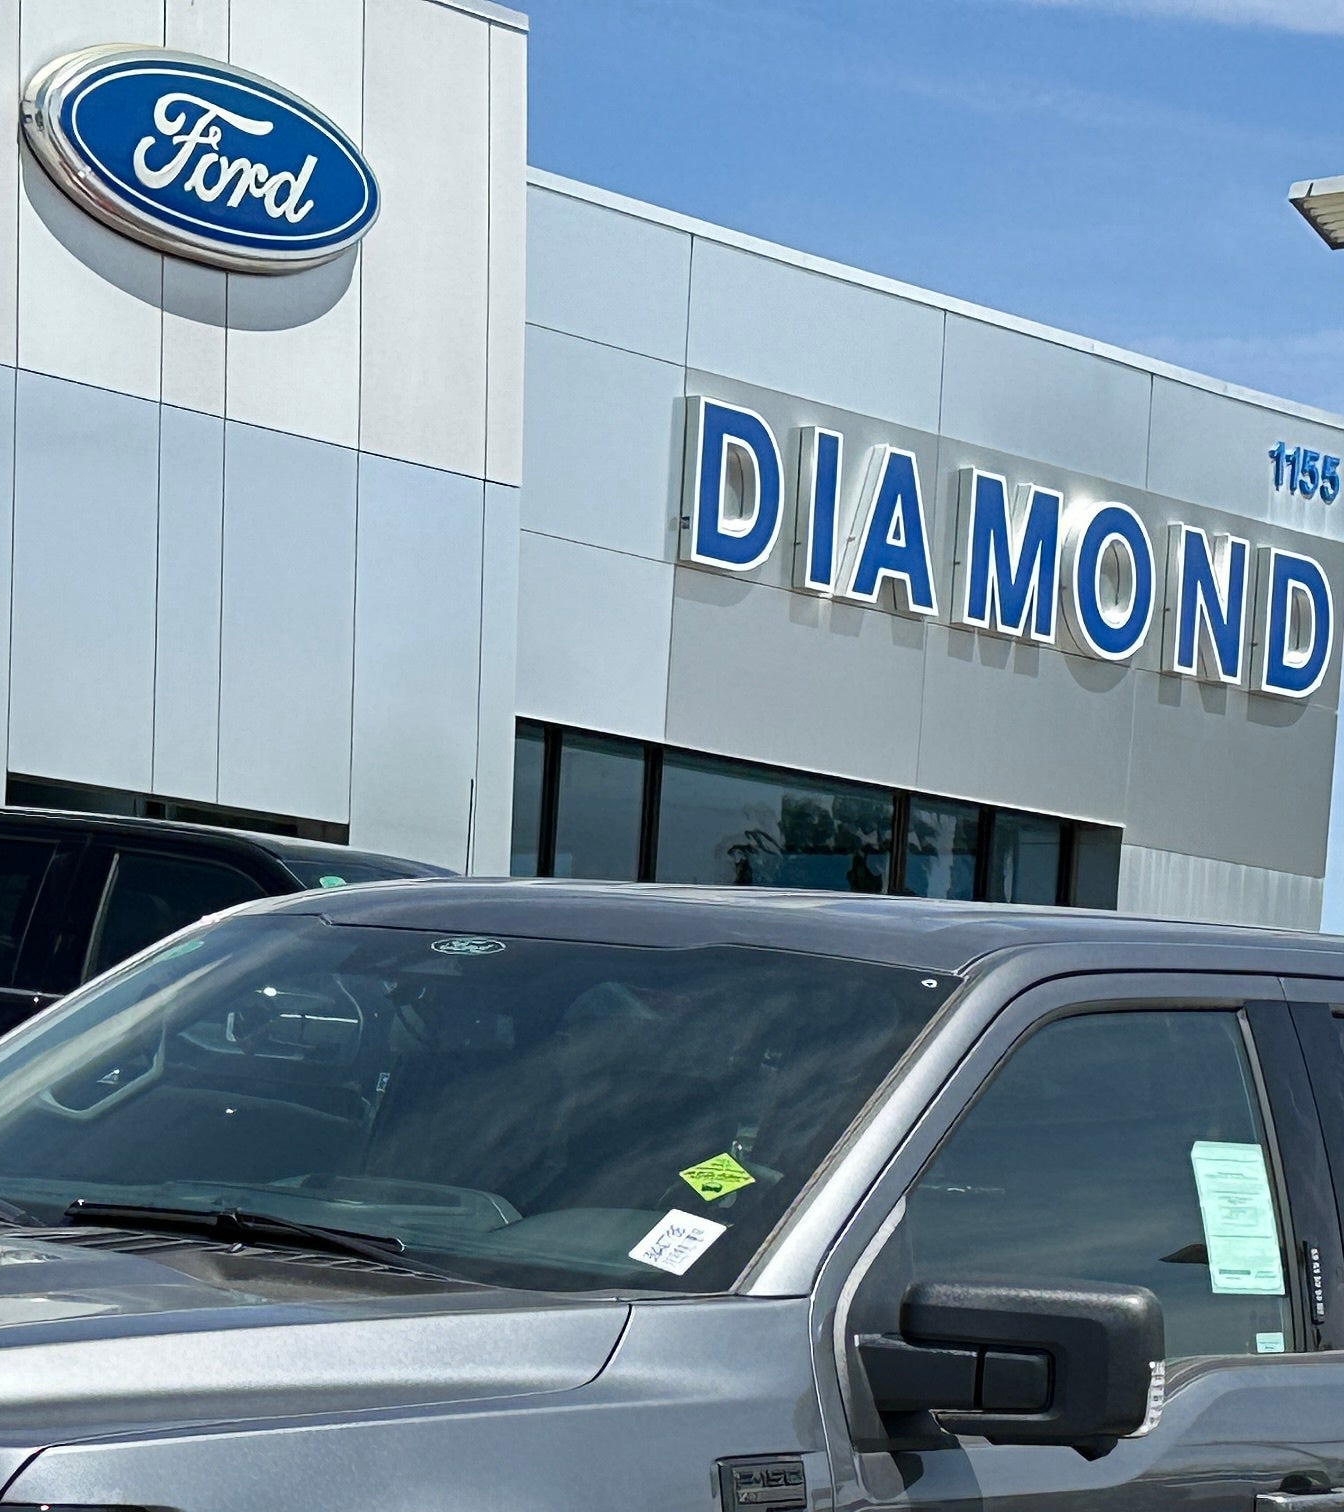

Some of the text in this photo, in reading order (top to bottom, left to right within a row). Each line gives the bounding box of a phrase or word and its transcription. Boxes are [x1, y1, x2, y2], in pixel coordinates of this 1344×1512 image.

[133, 91, 319, 224] Ford
[1267, 440, 1341, 505] 1155
[684, 395, 1336, 699] DIAMOND
